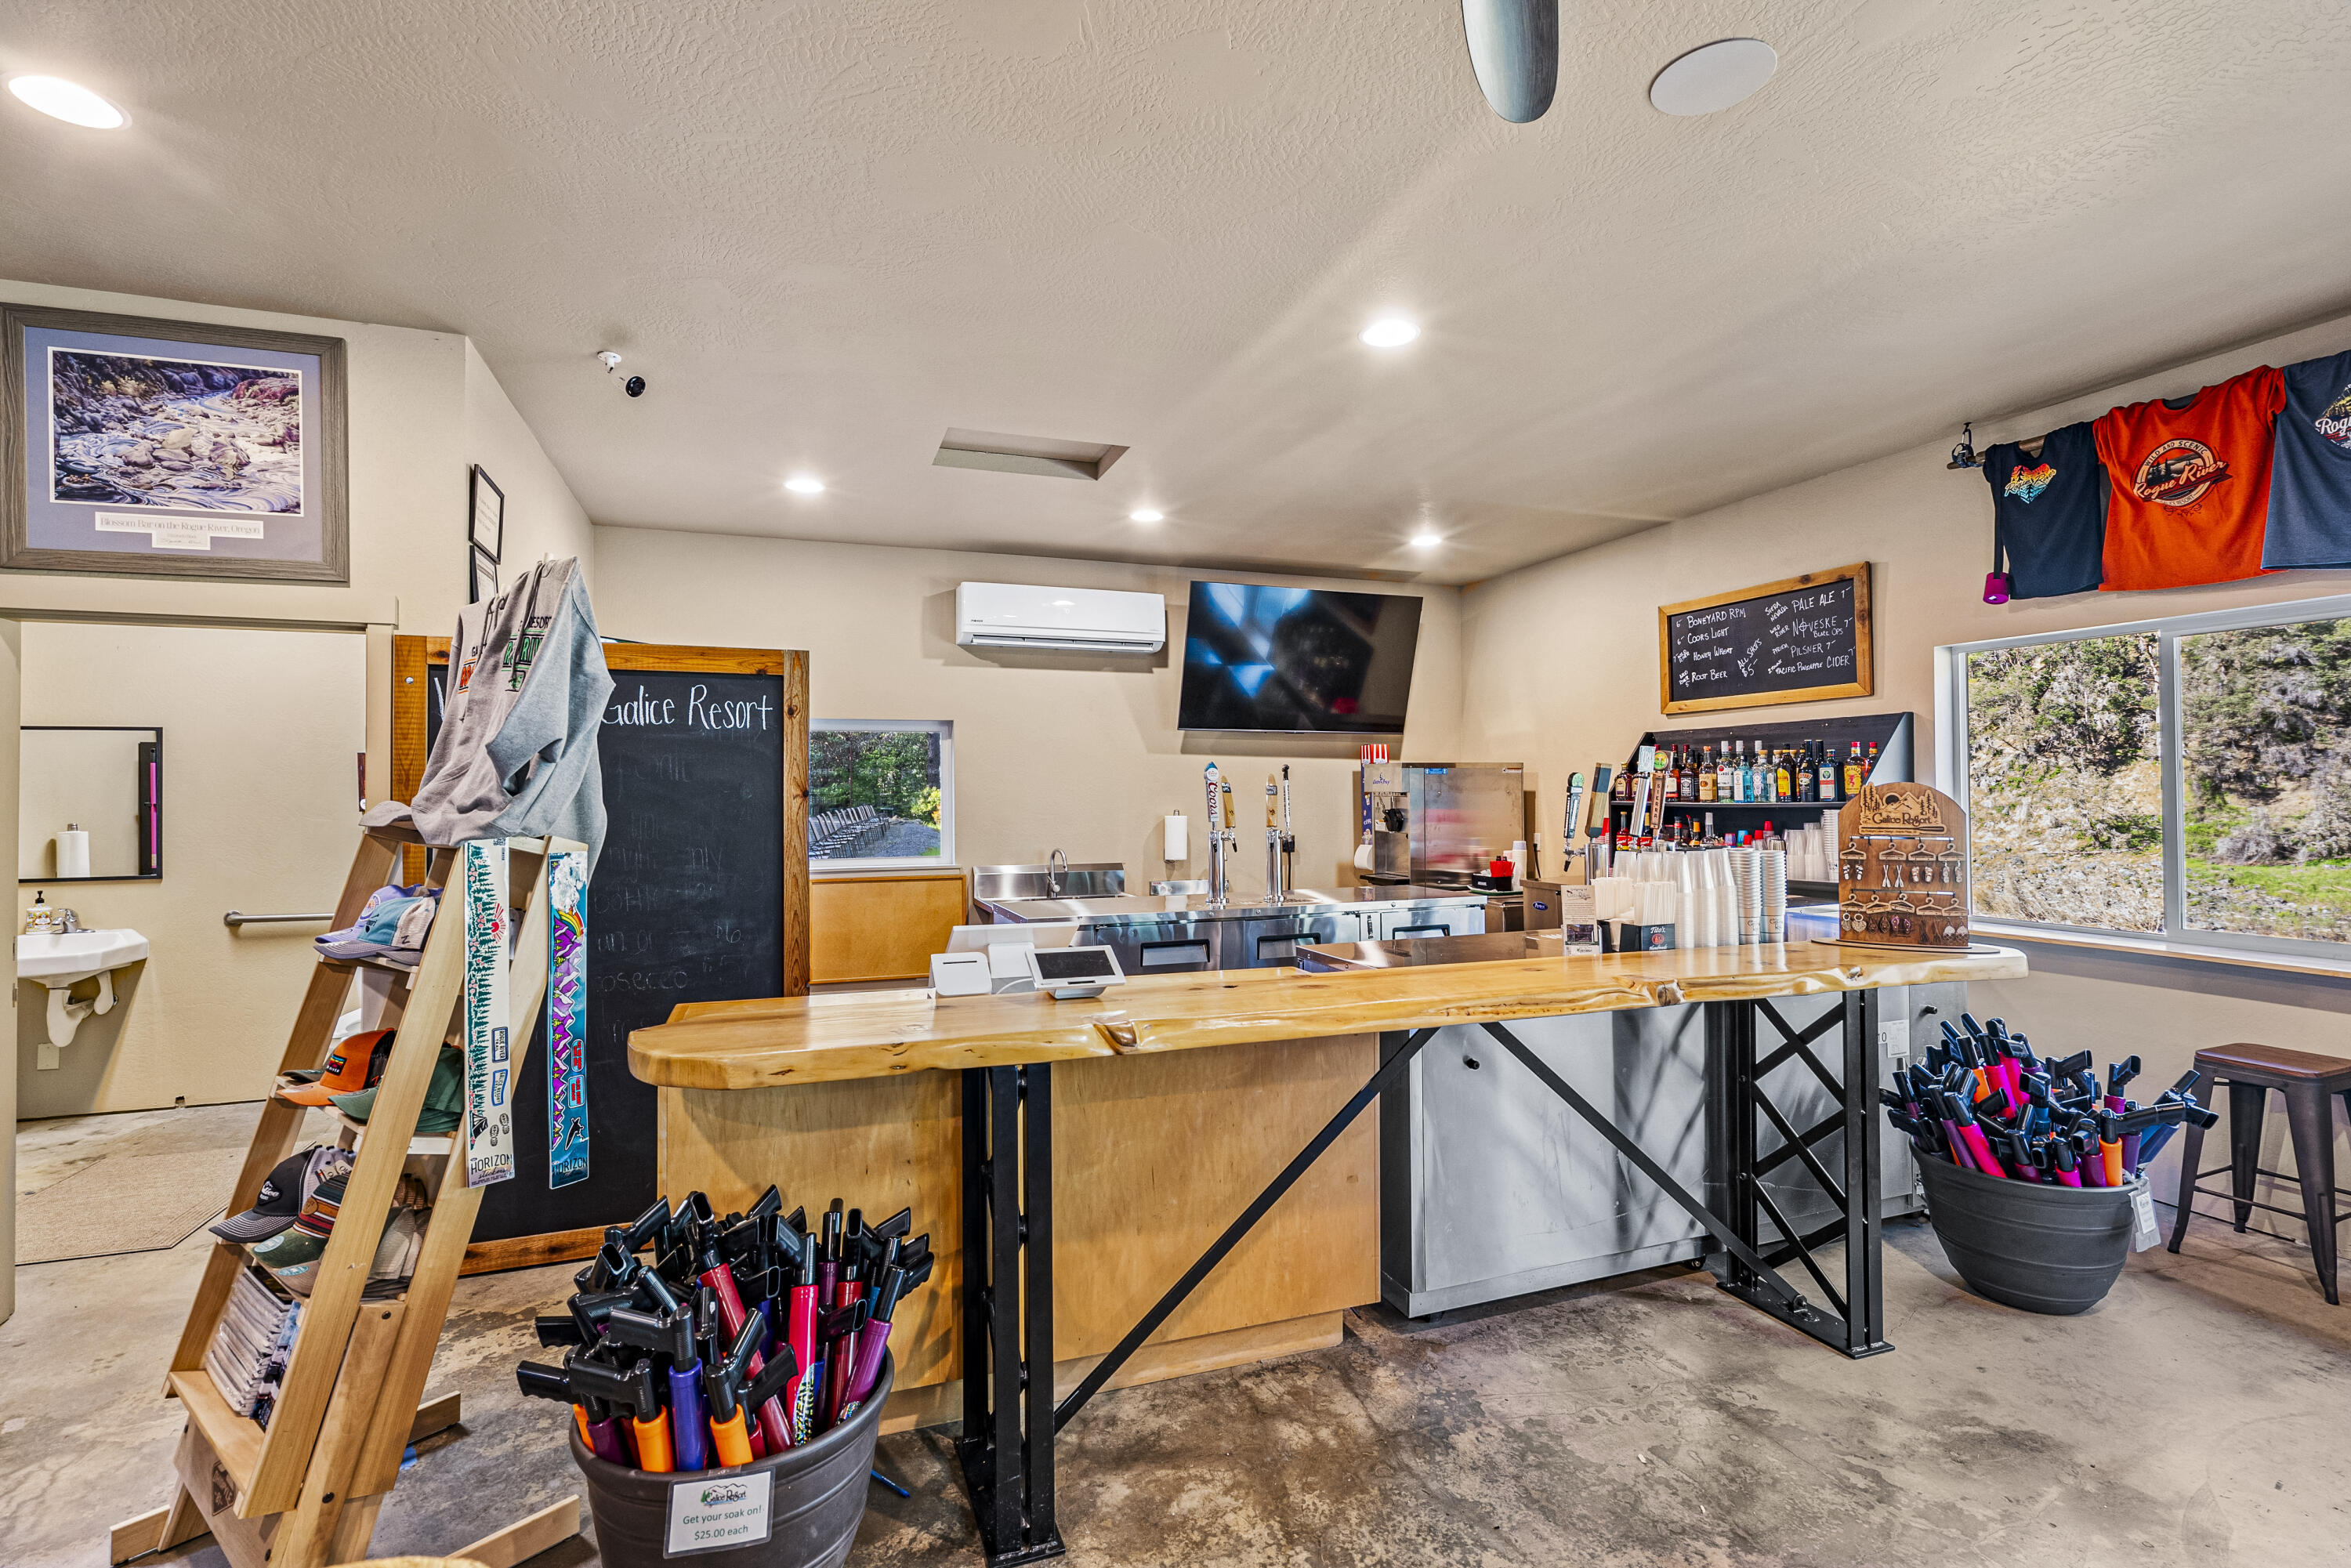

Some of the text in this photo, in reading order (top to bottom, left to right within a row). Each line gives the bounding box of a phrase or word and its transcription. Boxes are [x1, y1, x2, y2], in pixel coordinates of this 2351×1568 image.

[2144, 440, 2208, 466] WILD AND SCENIC
[2133, 461, 2226, 499] Rogue River
[100, 517, 136, 528] Blossom
[138, 520, 154, 529] Bar
[165, 521, 180, 531] the
[181, 523, 206, 533] Rogue
[208, 524, 230, 533] River,
[230, 525, 261, 534] Oregon
[1791, 596, 1815, 613] PALE
[1819, 590, 1835, 607] ALE
[1686, 611, 1727, 628] BONEYARD
[1730, 607, 1746, 620] RPM
[1770, 605, 1788, 622] NEVADA
[1687, 632, 1709, 644] COORS
[1711, 627, 1730, 639] LIGHT
[1774, 625, 1790, 638] RIVER
[1831, 628, 1843, 636] OPS
[1694, 646, 1733, 661] HONEY WHEAT
[1737, 638, 1762, 670] ALL SHOTS
[1791, 643, 1824, 658] PILSNER
[1775, 665, 1796, 675] PACIFIC
[1826, 655, 1850, 668] CIDER
[1692, 668, 1728, 683] ROOT BEER
[689, 684, 773, 730] Resort
[1208, 782, 1219, 815] Coors
[1872, 812, 1933, 827] Galice Resort
[470, 1153, 512, 1175] HORIZON
[552, 1157, 588, 1175] HORIZON
[478, 1167, 506, 1179] stickers
[683, 1505, 762, 1525] Get your soak on!
[694, 1525, 748, 1541] $25.00 each
